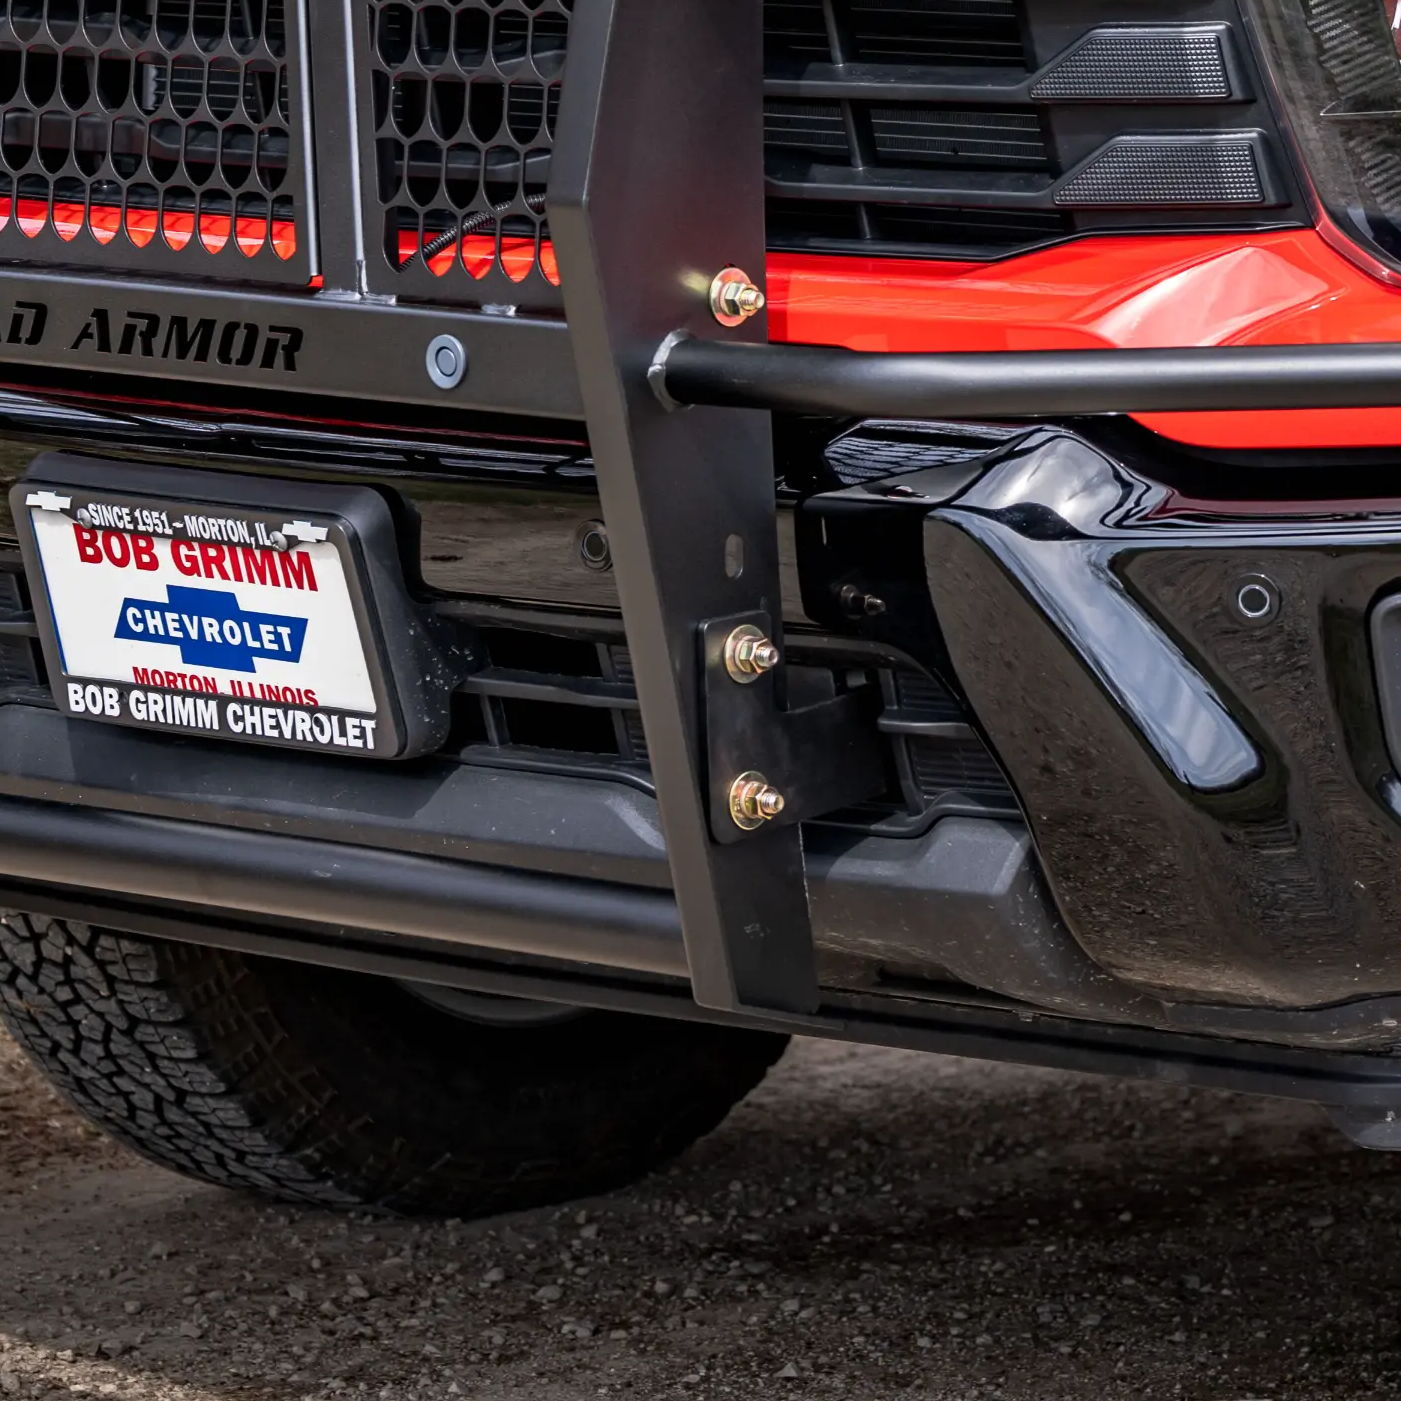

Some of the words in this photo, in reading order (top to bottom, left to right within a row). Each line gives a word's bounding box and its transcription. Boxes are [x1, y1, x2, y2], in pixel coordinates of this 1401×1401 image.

[70, 307, 304, 372] ARMOR
[87, 503, 134, 530] SINCE
[134, 508, 174, 536] 1951
[184, 514, 256, 548] MORTON,
[254, 522, 272, 546] IL
[72, 523, 160, 571] BOB
[170, 539, 319, 592] GRIMM
[126, 606, 293, 653] CHEVROLET
[67, 683, 122, 717] BOB
[128, 689, 220, 731] GRIMM
[226, 702, 377, 750] CHEVROLET
[230, 680, 320, 708] ILLINOIS
